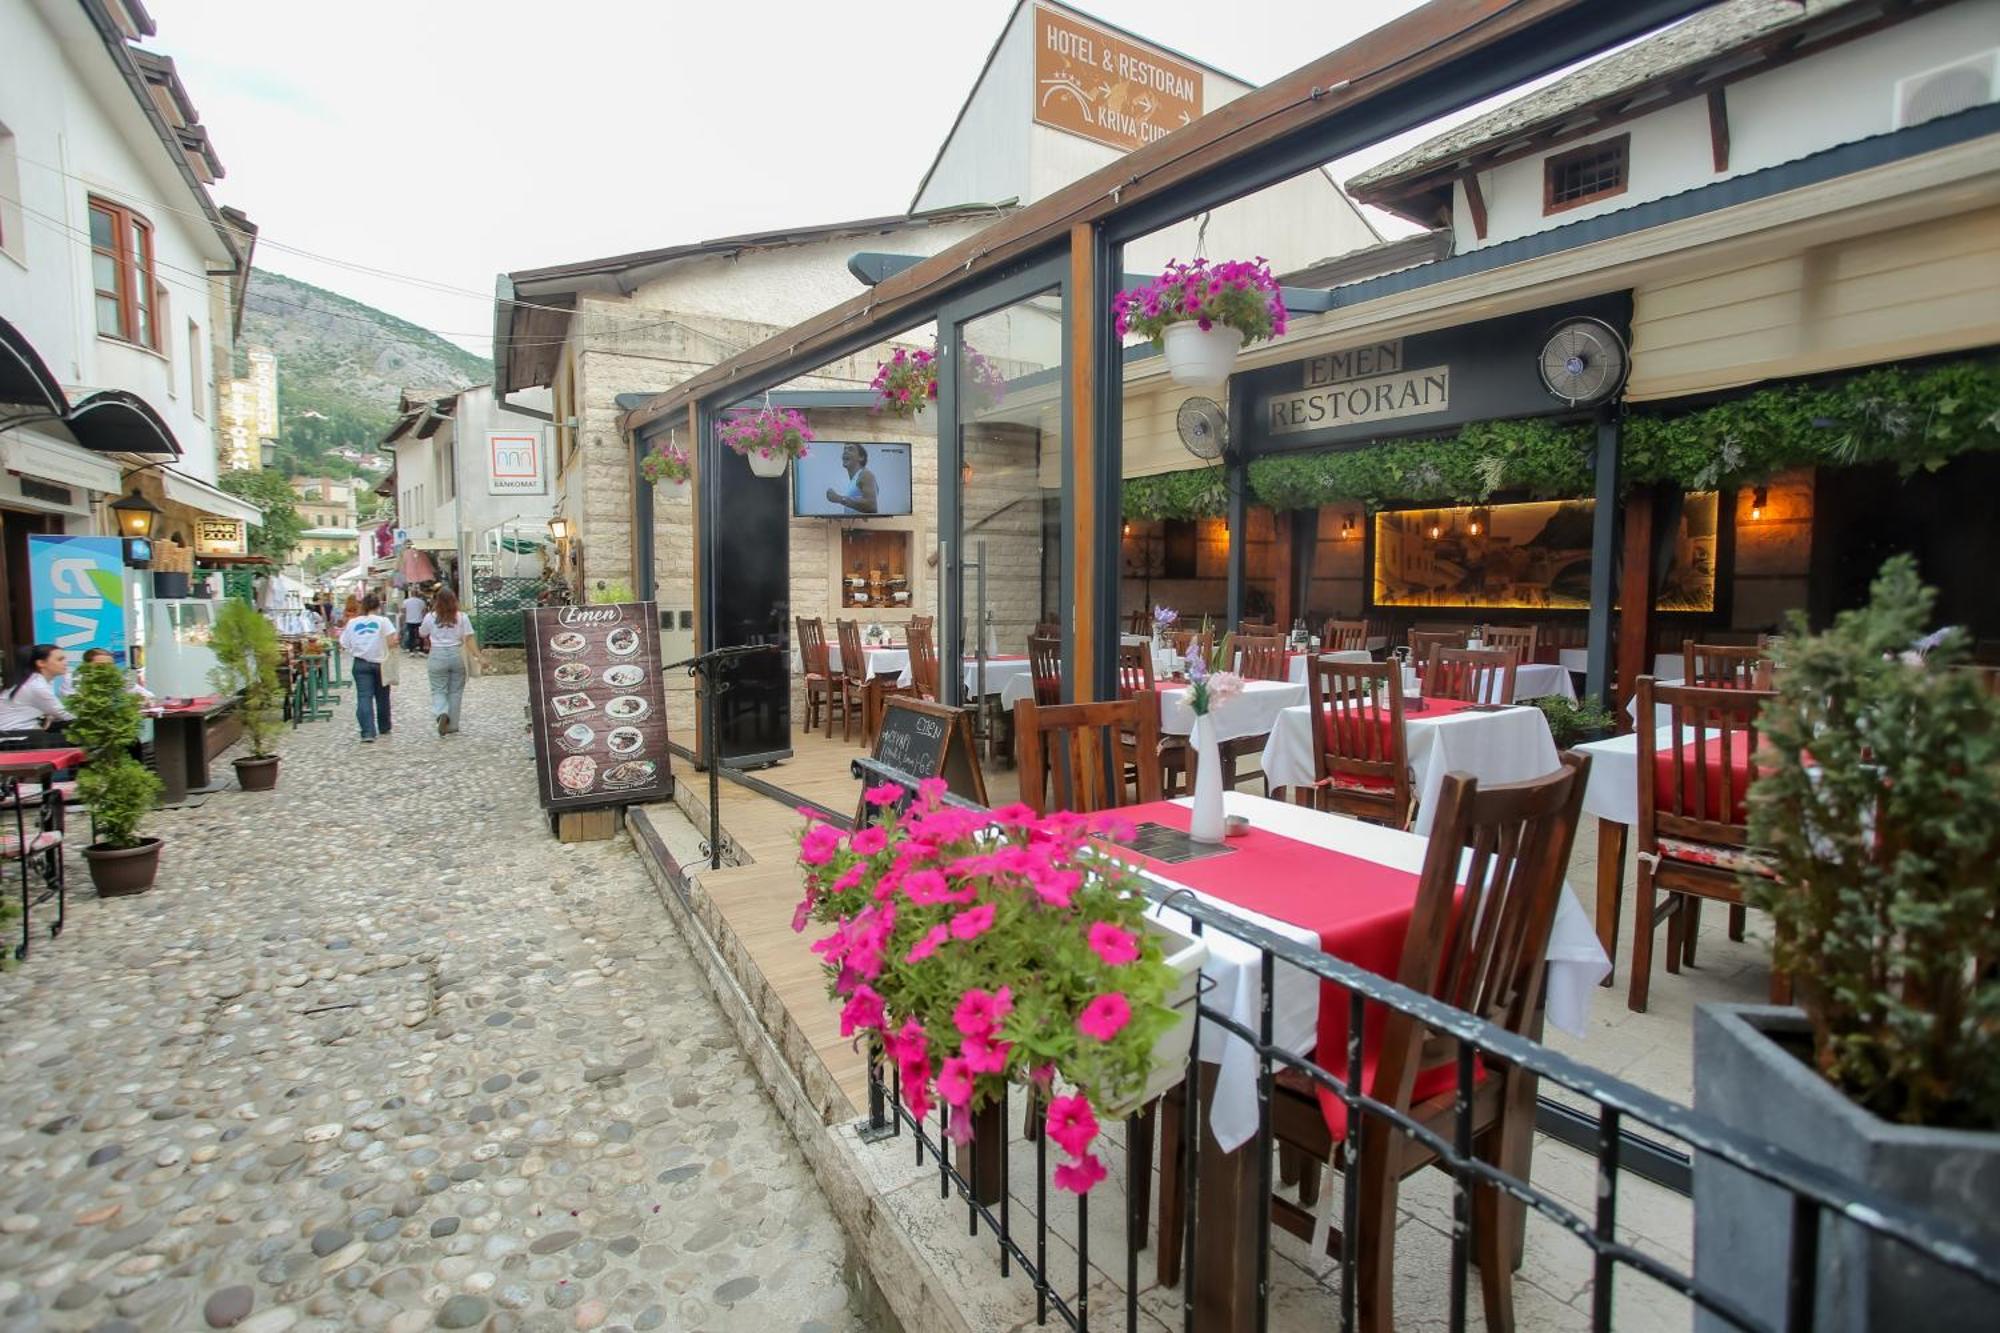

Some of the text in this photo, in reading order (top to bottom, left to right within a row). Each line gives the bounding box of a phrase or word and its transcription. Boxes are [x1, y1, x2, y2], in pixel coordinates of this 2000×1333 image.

[1047, 24, 1194, 103] HOTEL & RESTORAN
[1098, 105, 1138, 139] KRIVA
[1310, 341, 1398, 385] EMEN
[1270, 374, 1447, 427] RESTORAN
[203, 531, 236, 540] 2000
[204, 523, 236, 532] BAR
[565, 606, 617, 623] Emen
